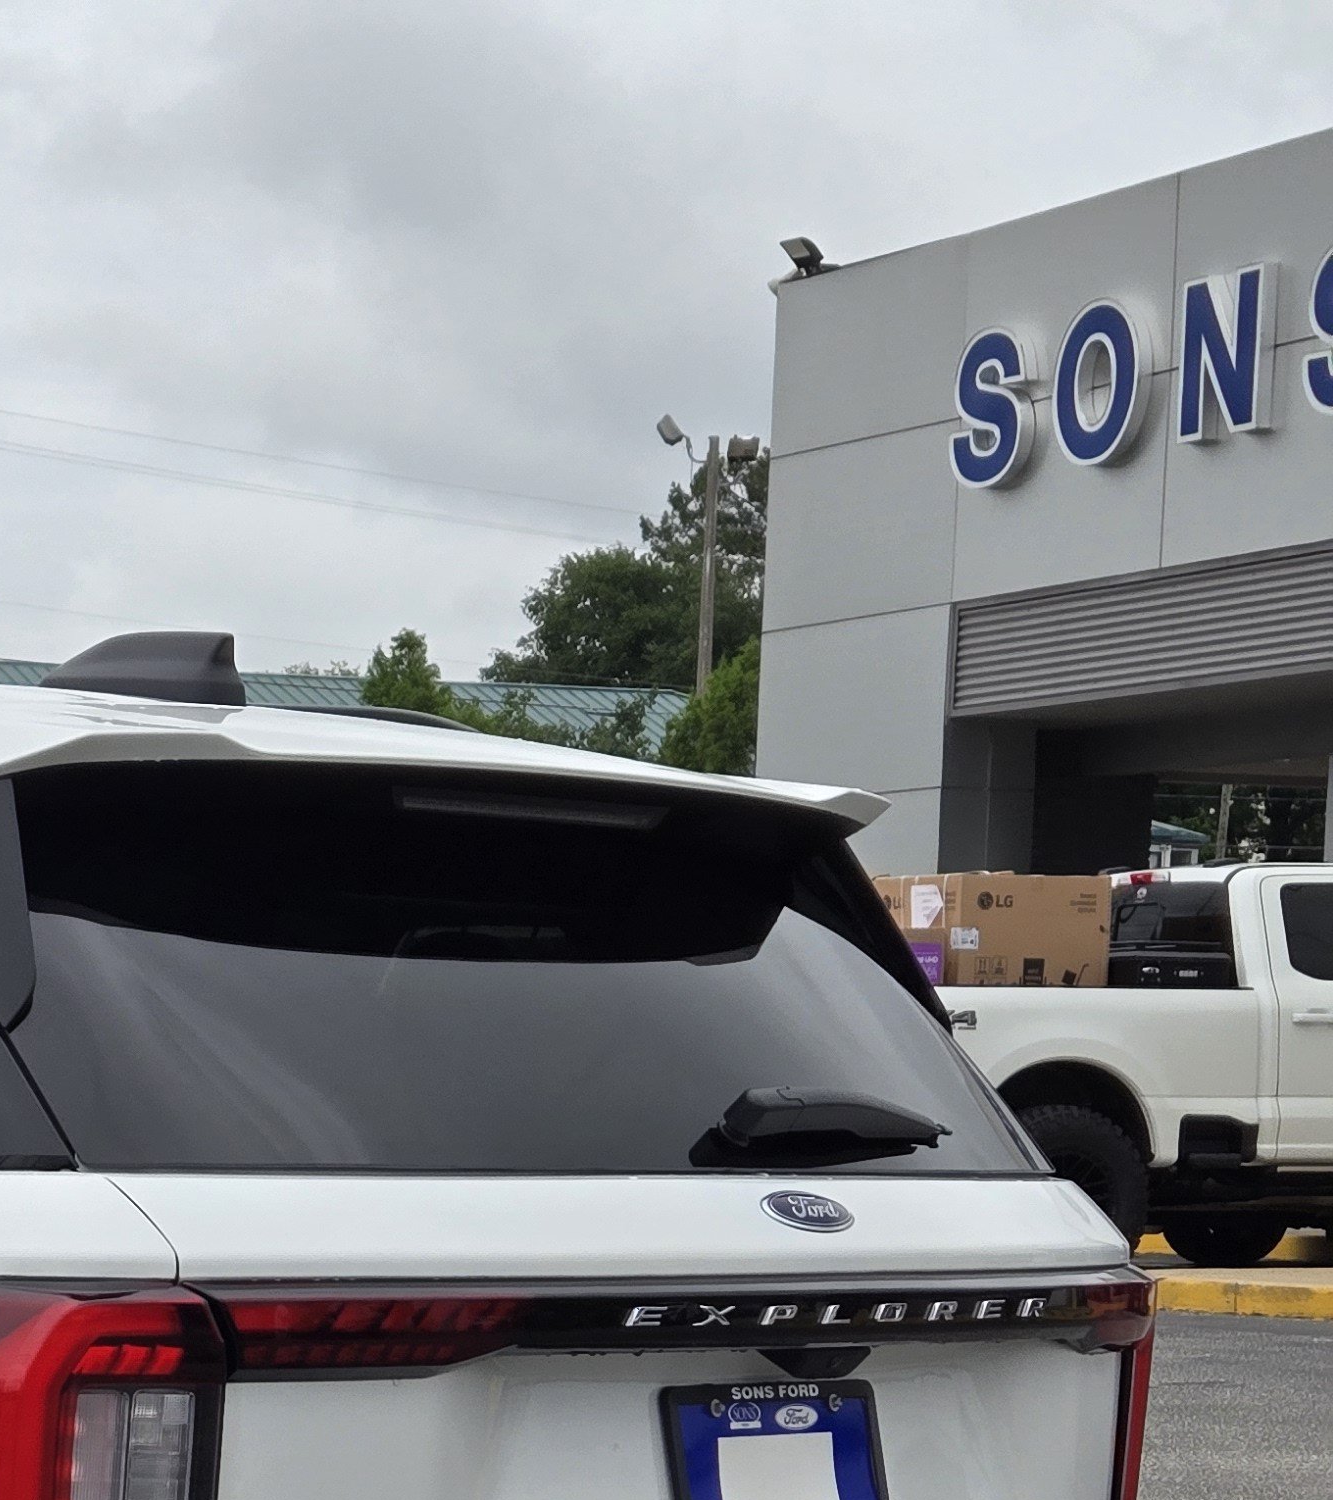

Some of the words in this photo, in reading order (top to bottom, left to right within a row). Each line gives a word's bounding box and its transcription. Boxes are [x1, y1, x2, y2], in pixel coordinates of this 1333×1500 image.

[787, 1195, 840, 1219] Ford
[622, 1297, 1050, 1327] EXPLORER
[731, 1386, 775, 1400] SONS
[778, 1384, 820, 1397] FORD
[732, 1406, 756, 1420] SONS
[784, 1408, 810, 1426] Ford
